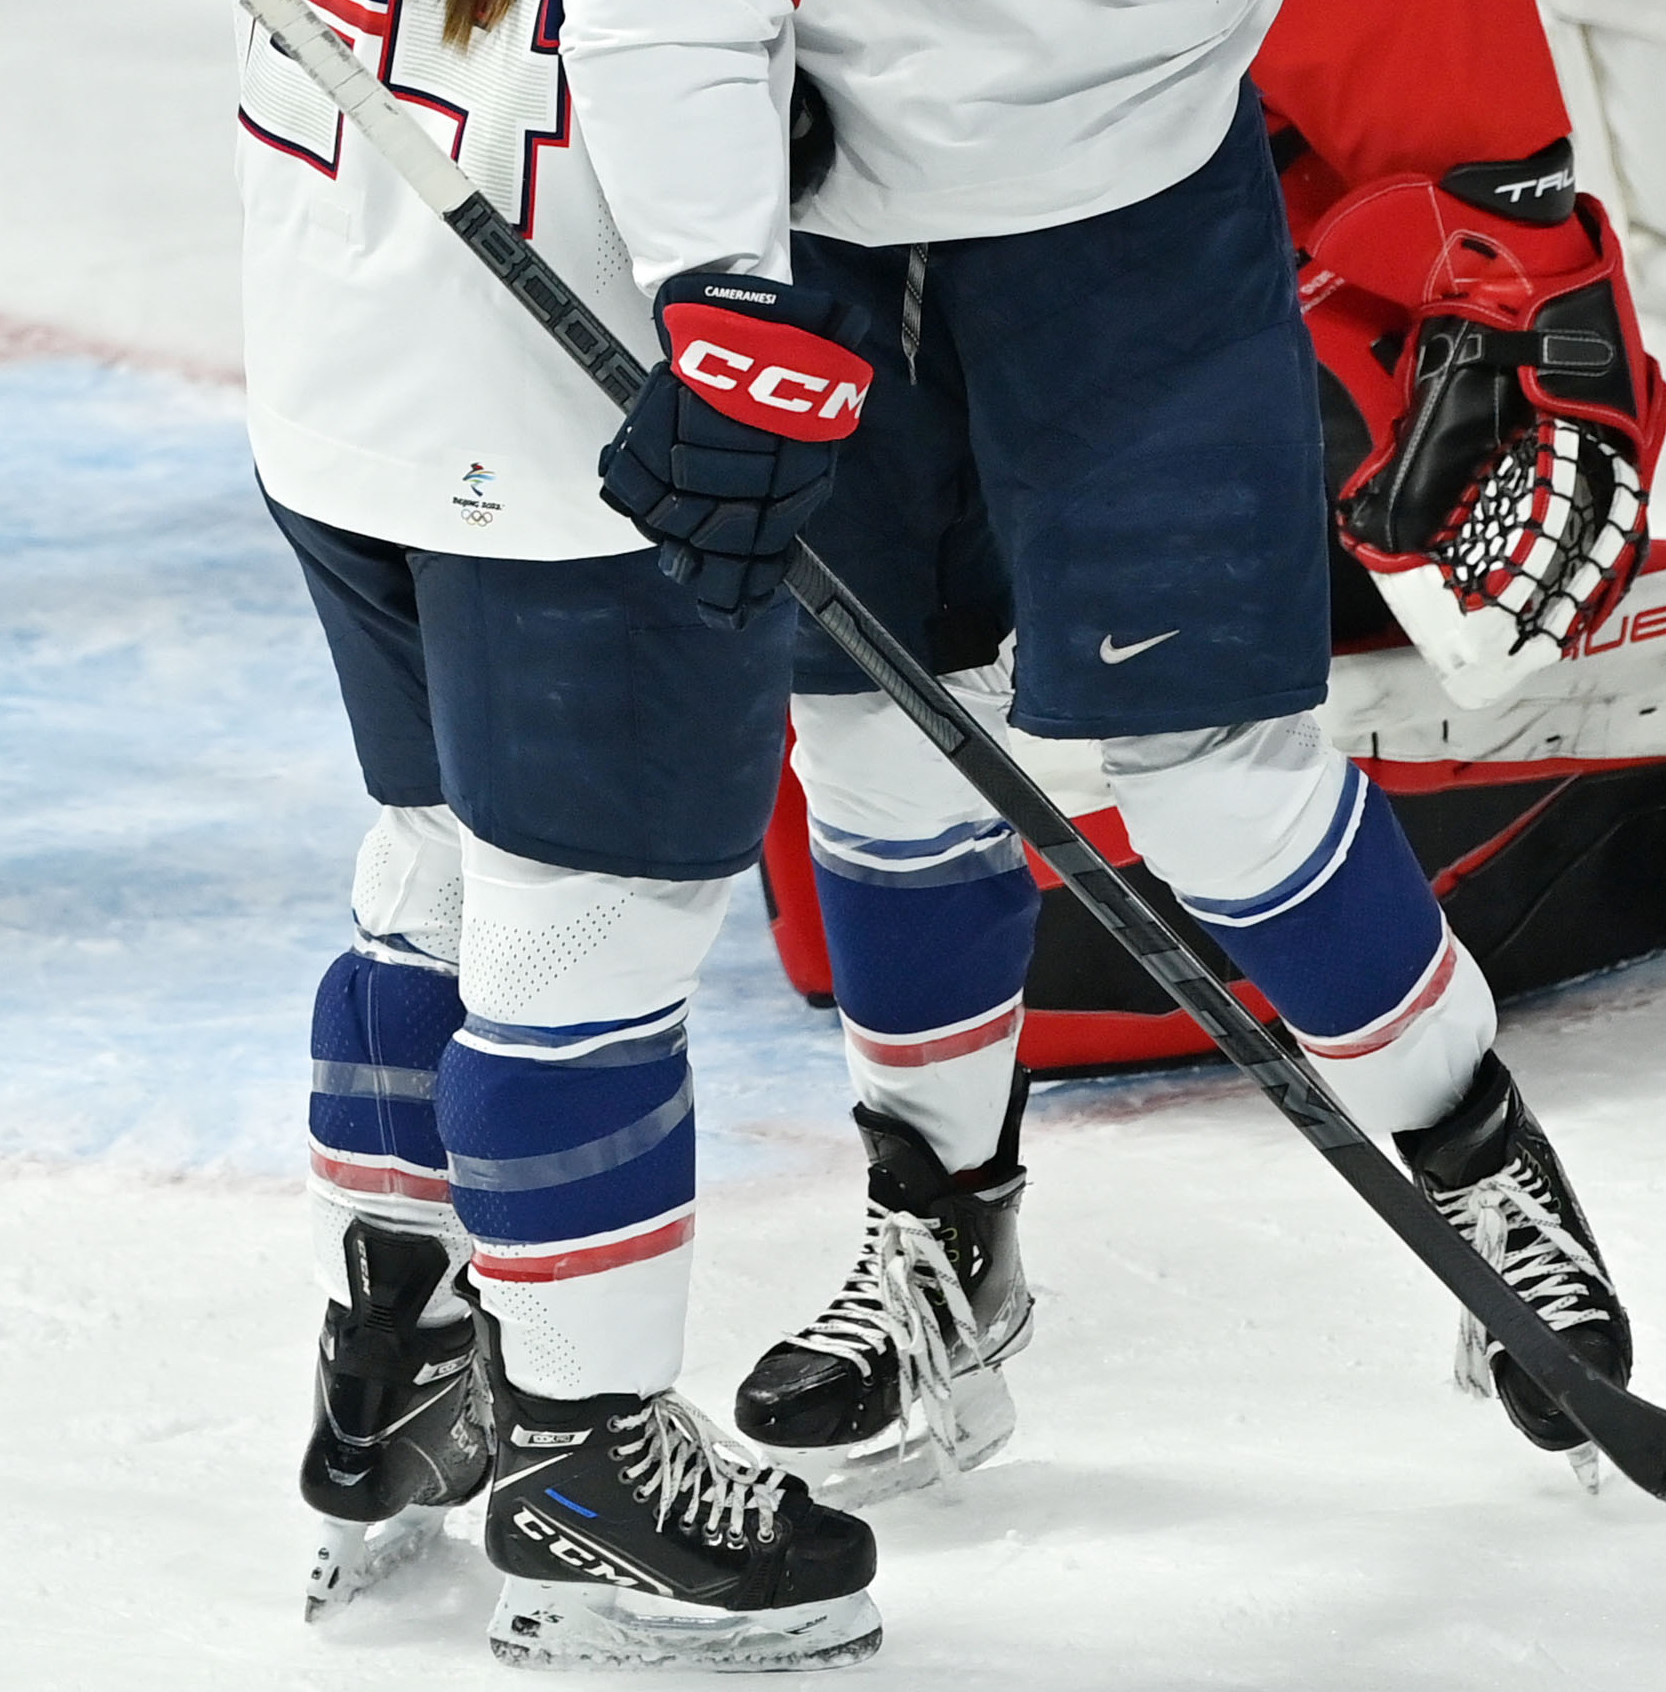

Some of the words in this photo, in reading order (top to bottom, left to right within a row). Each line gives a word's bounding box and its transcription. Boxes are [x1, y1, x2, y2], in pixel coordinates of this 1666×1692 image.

[704, 284, 777, 305] CAMERANESI
[677, 338, 875, 421] CCM
[449, 1415, 479, 1460] CCM
[511, 1506, 641, 1588] CCM
